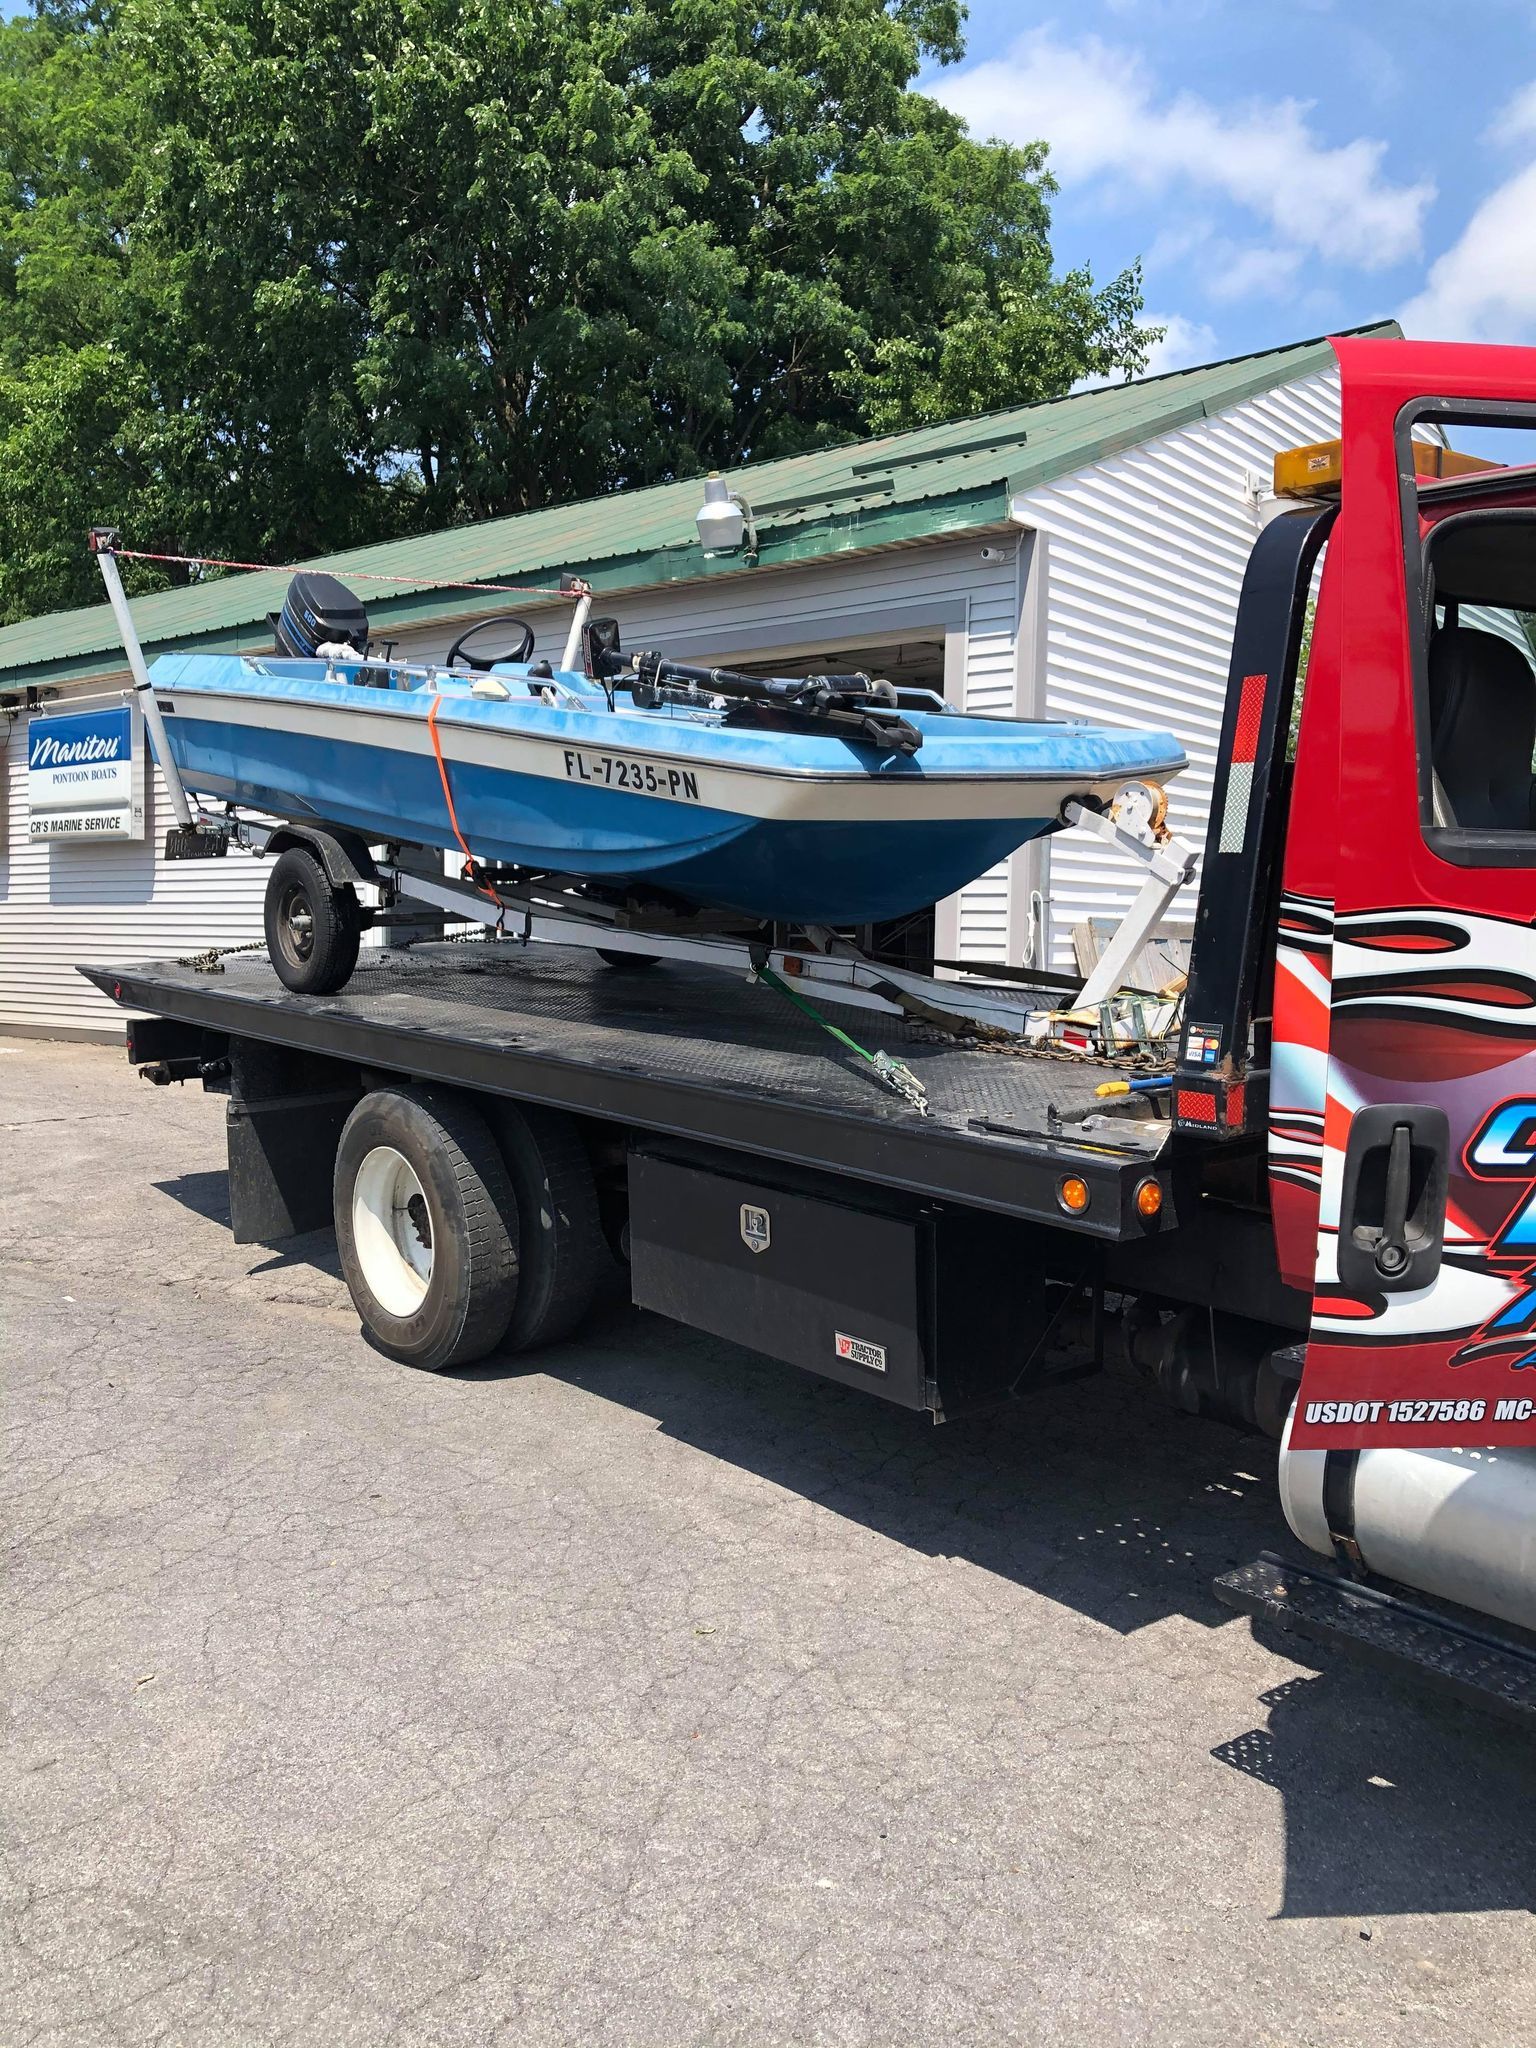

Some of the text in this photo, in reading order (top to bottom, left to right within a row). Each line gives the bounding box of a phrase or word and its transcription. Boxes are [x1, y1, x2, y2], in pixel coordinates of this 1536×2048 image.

[30, 734, 119, 767] Manitou
[52, 767, 117, 785] PONTOON BOATS
[564, 751, 699, 799] FL-7235-PN
[30, 816, 120, 834] CR'S MARINE SERVICE
[851, 1341, 882, 1359] TRACTOR
[851, 1350, 875, 1365] SUPPLY
[1305, 1401, 1384, 1424] USDOT
[1388, 1400, 1487, 1422] 1527586
